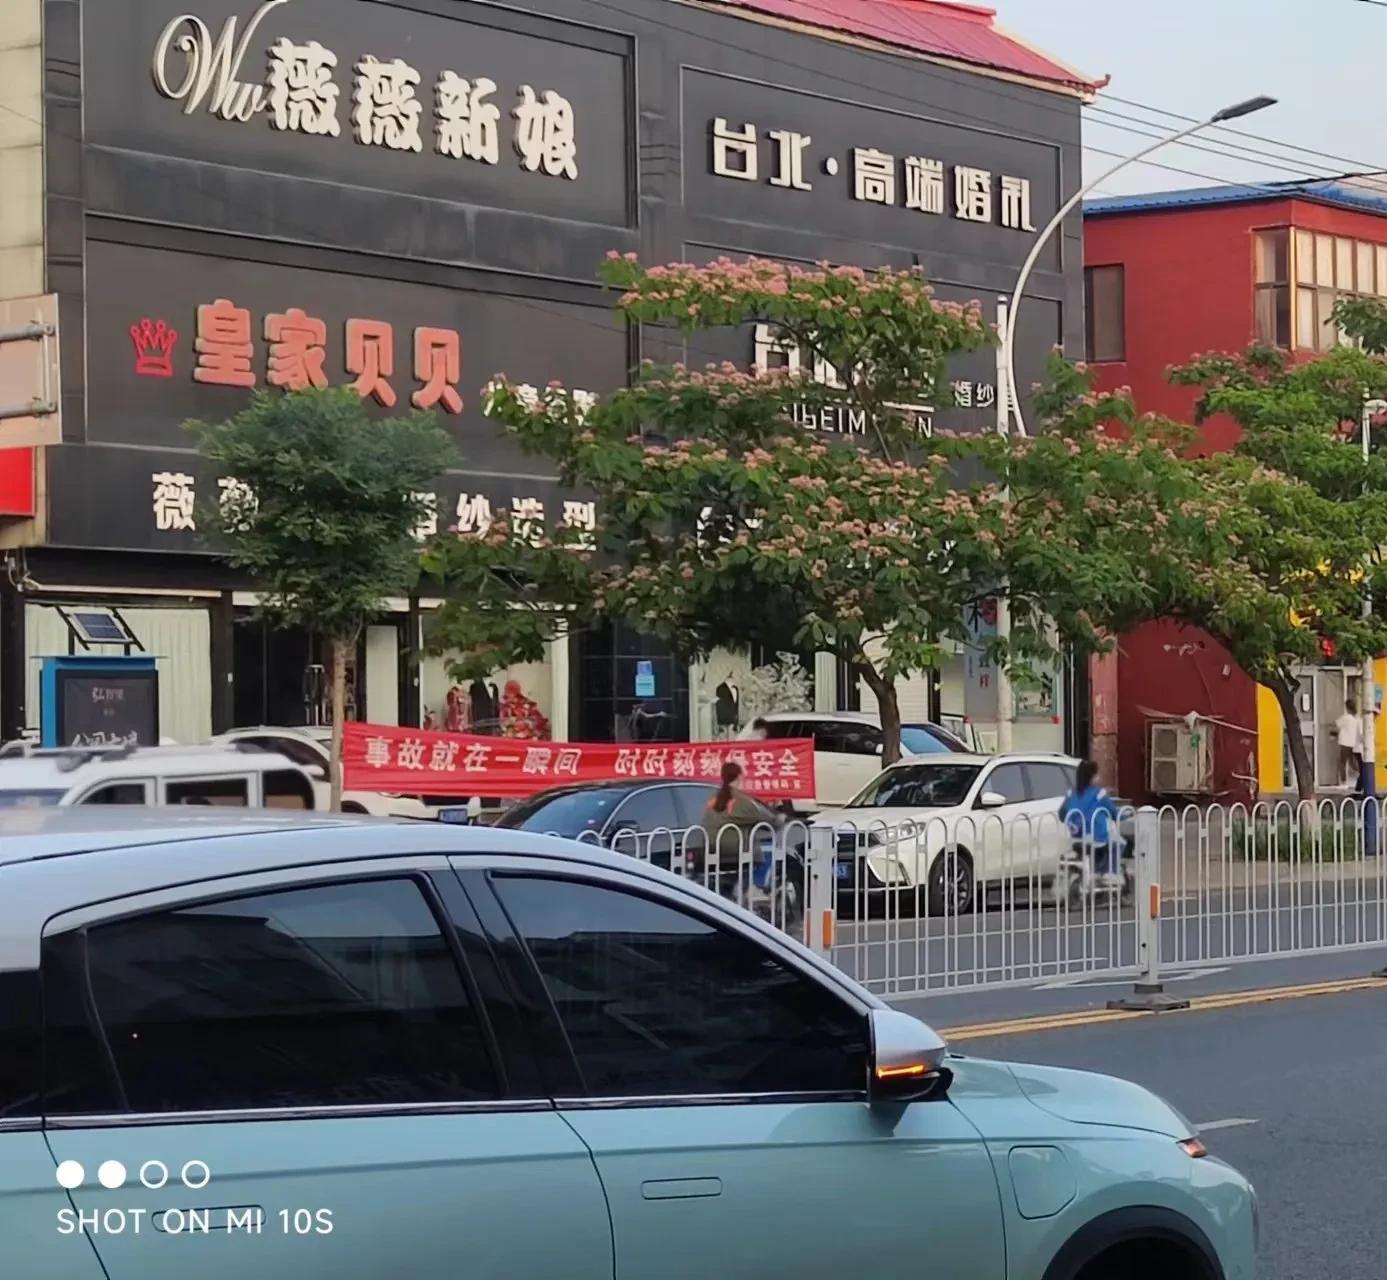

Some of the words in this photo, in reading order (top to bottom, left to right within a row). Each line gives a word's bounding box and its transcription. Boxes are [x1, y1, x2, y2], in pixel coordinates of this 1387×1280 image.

[267, 37, 578, 180] 薇薇新娘
[194, 299, 463, 415] 皇家贝贝
[365, 735, 582, 775] 事故就在一瞬间
